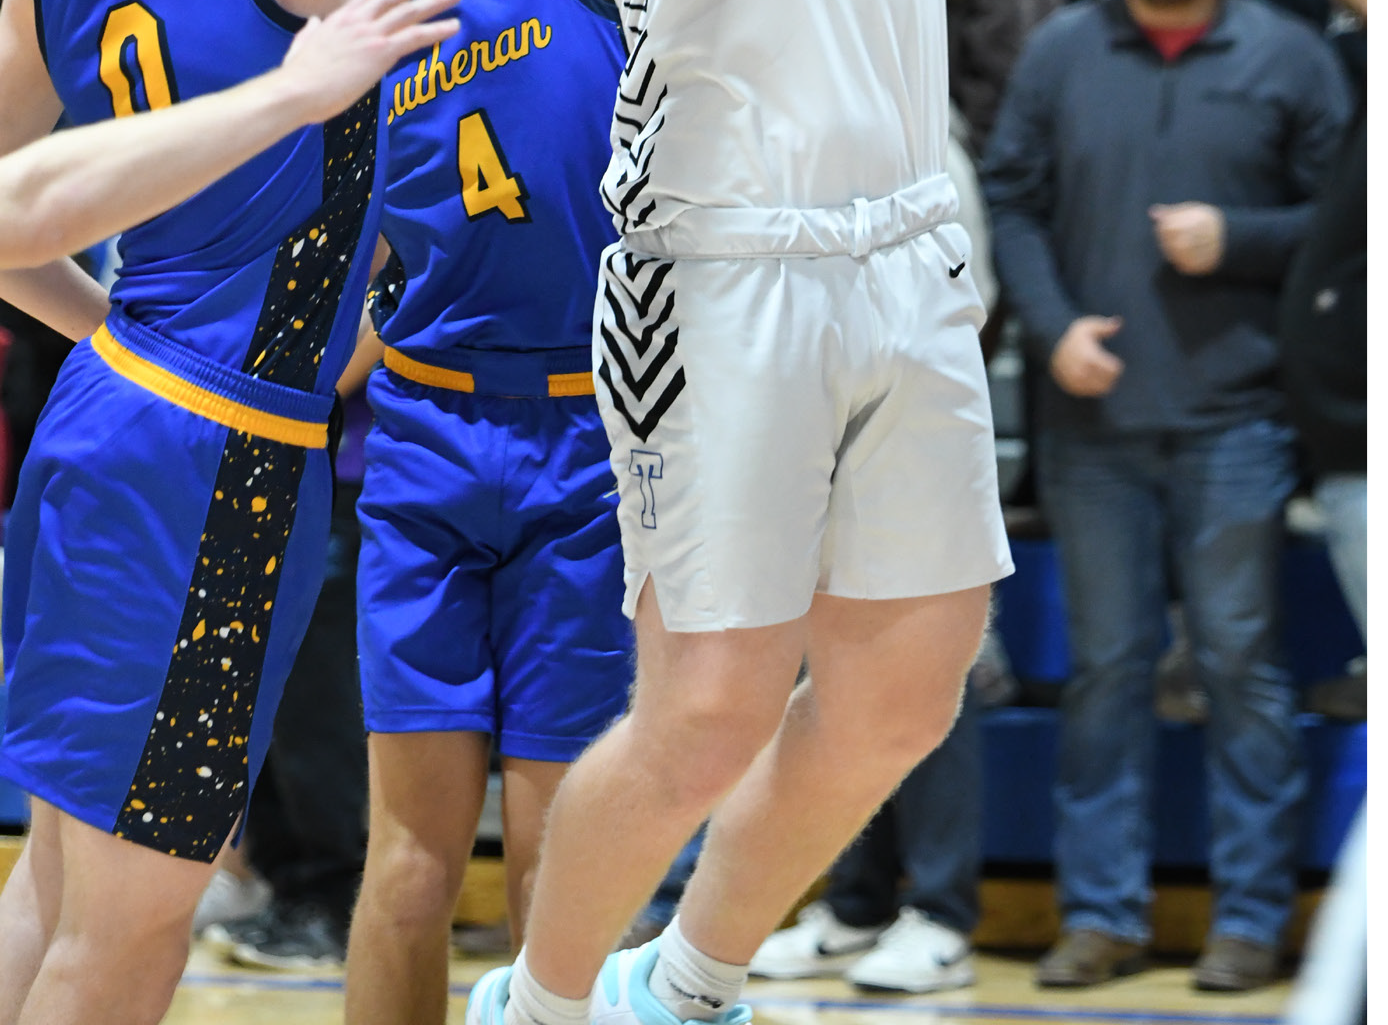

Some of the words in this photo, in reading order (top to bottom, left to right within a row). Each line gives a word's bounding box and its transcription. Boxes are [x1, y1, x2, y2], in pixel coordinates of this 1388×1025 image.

[387, 17, 552, 126] utheran
[458, 107, 533, 223] 4
[629, 449, 663, 529] T
